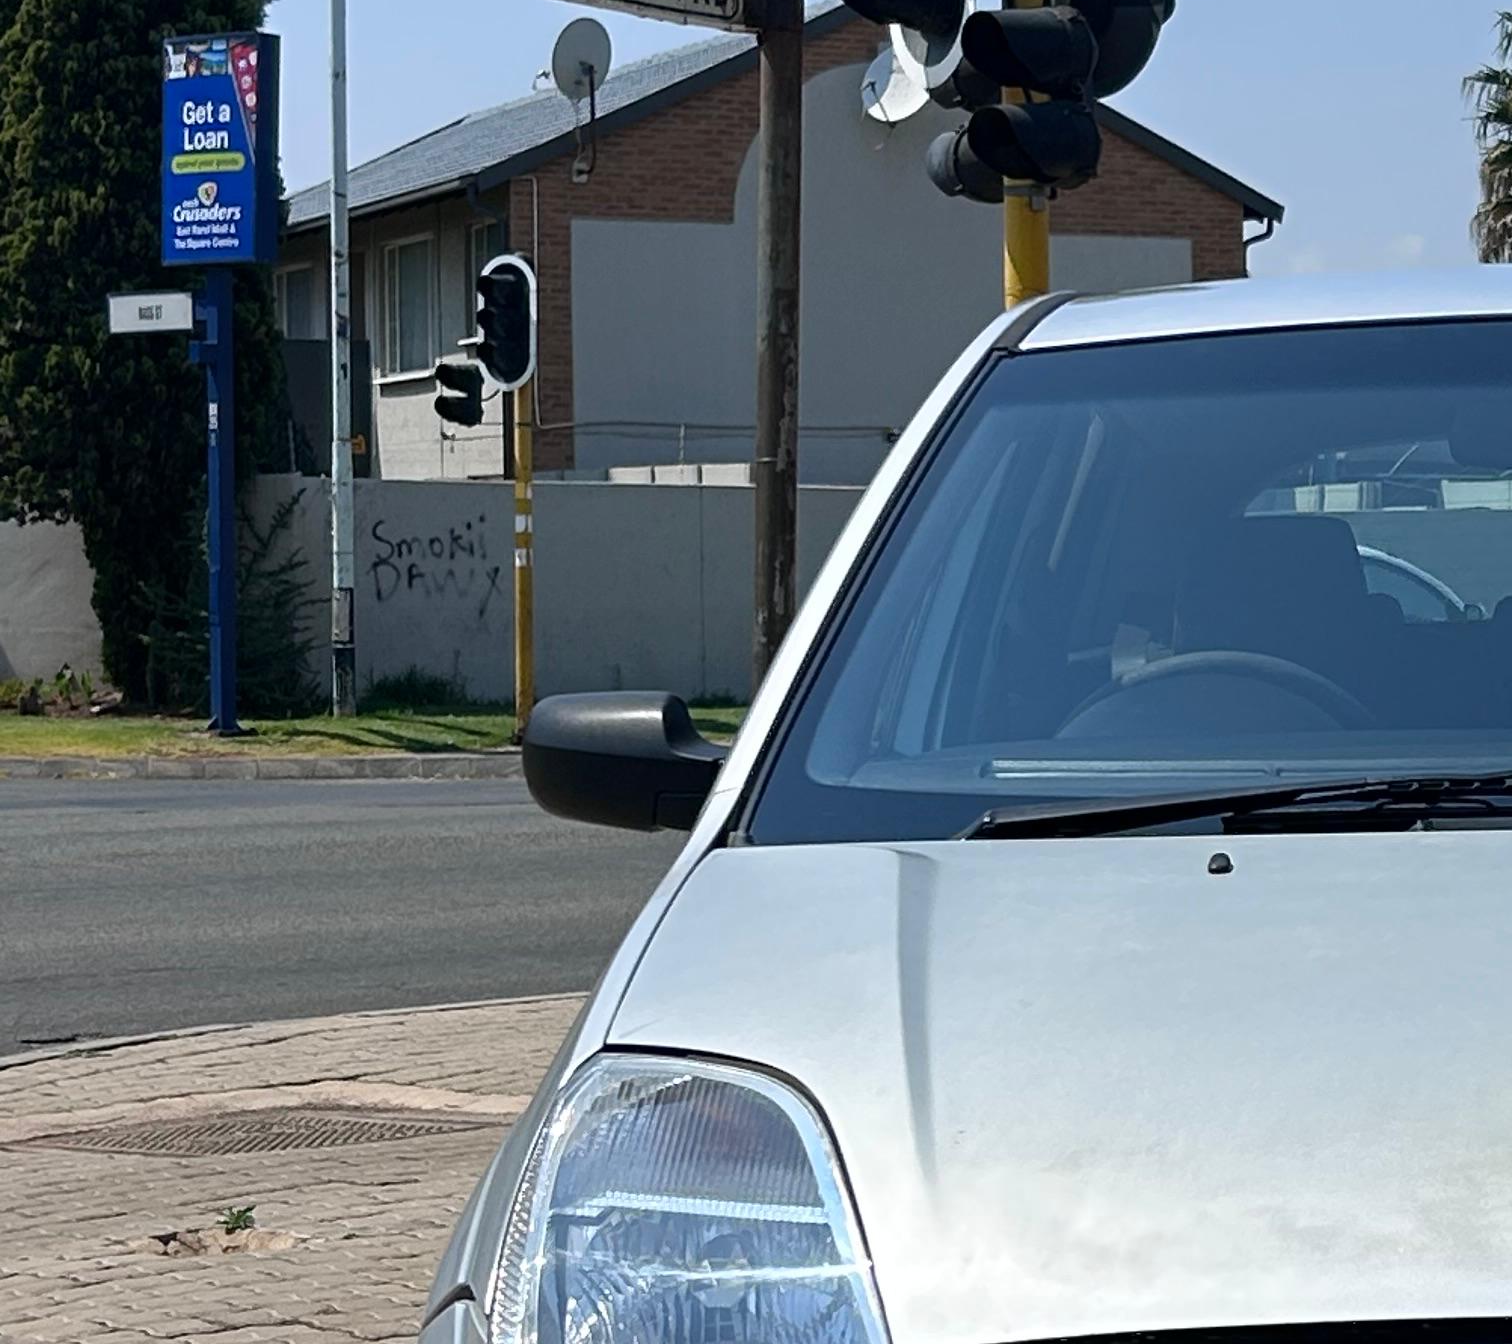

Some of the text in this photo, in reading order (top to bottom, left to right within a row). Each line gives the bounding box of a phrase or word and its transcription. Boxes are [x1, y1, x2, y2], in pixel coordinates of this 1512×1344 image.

[182, 100, 231, 125] Get a
[183, 126, 229, 151] Loan
[172, 202, 242, 223] Crusaders
